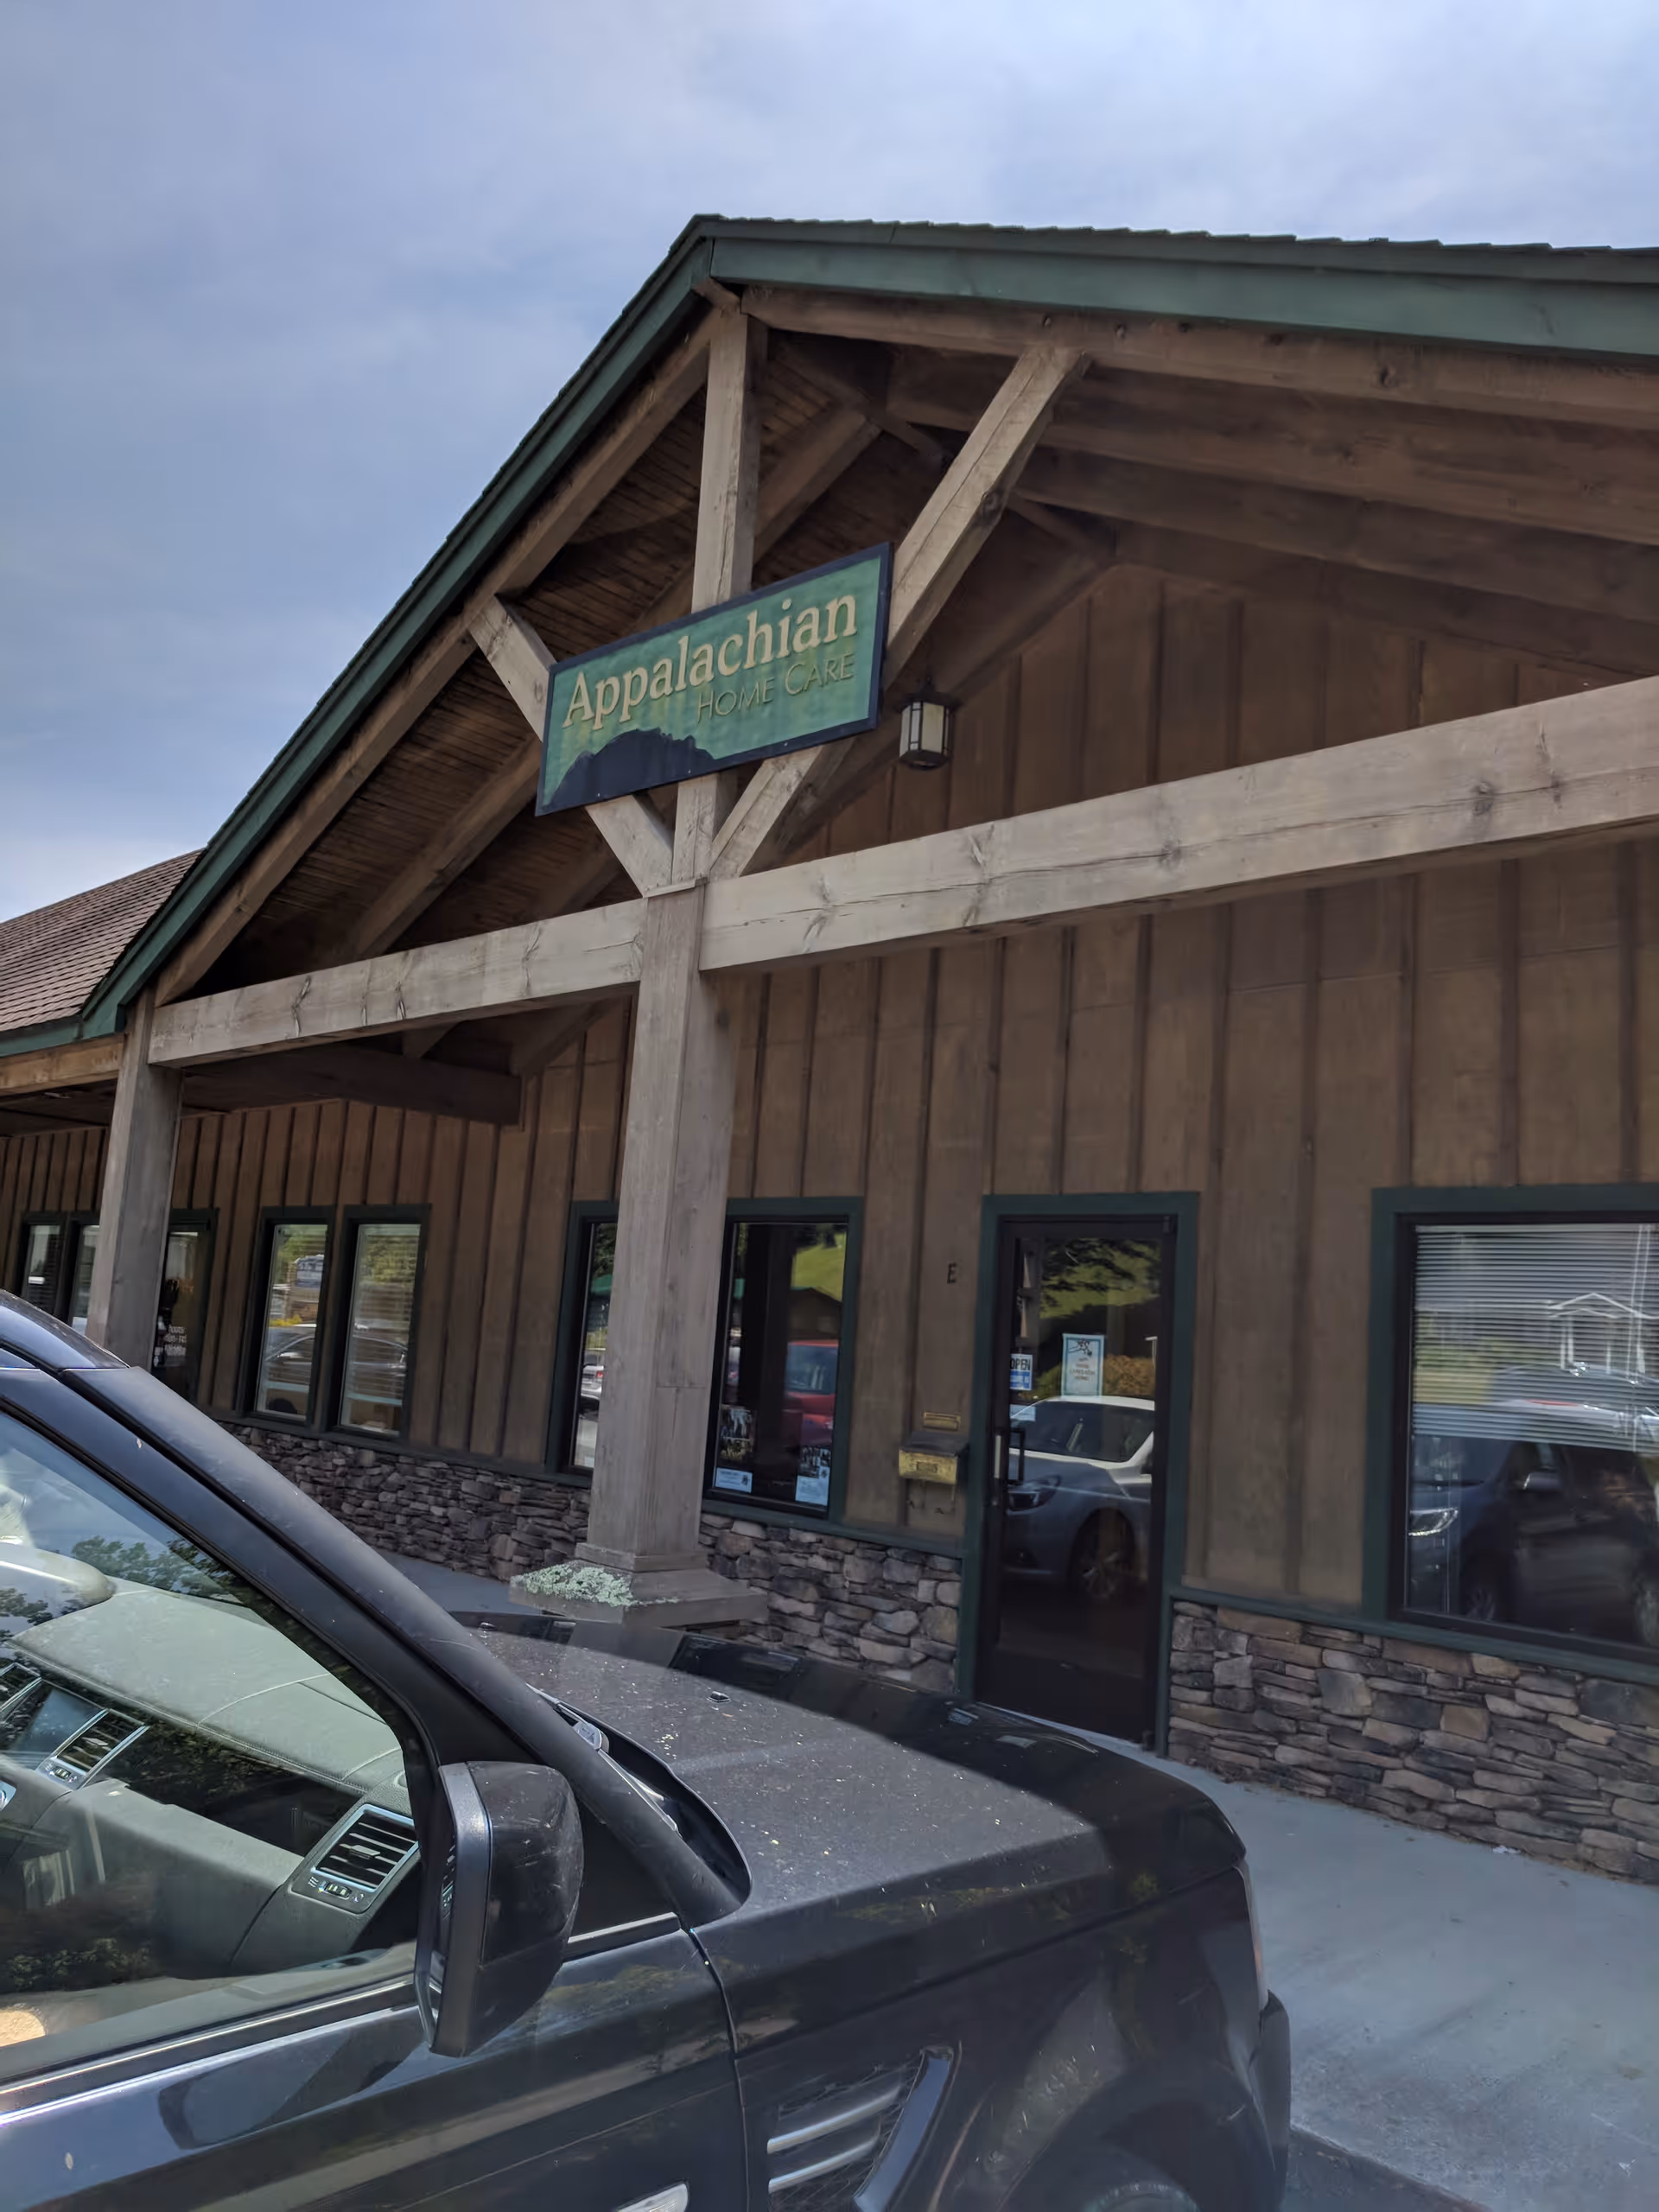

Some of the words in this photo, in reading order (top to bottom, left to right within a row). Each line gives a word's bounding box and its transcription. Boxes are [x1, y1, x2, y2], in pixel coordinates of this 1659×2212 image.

[563, 594, 858, 730] Appalachian
[696, 677, 775, 722] HOME
[785, 652, 855, 695] CARE
[948, 1262, 957, 1284] E
[1010, 1358, 1031, 1370] OPEN
